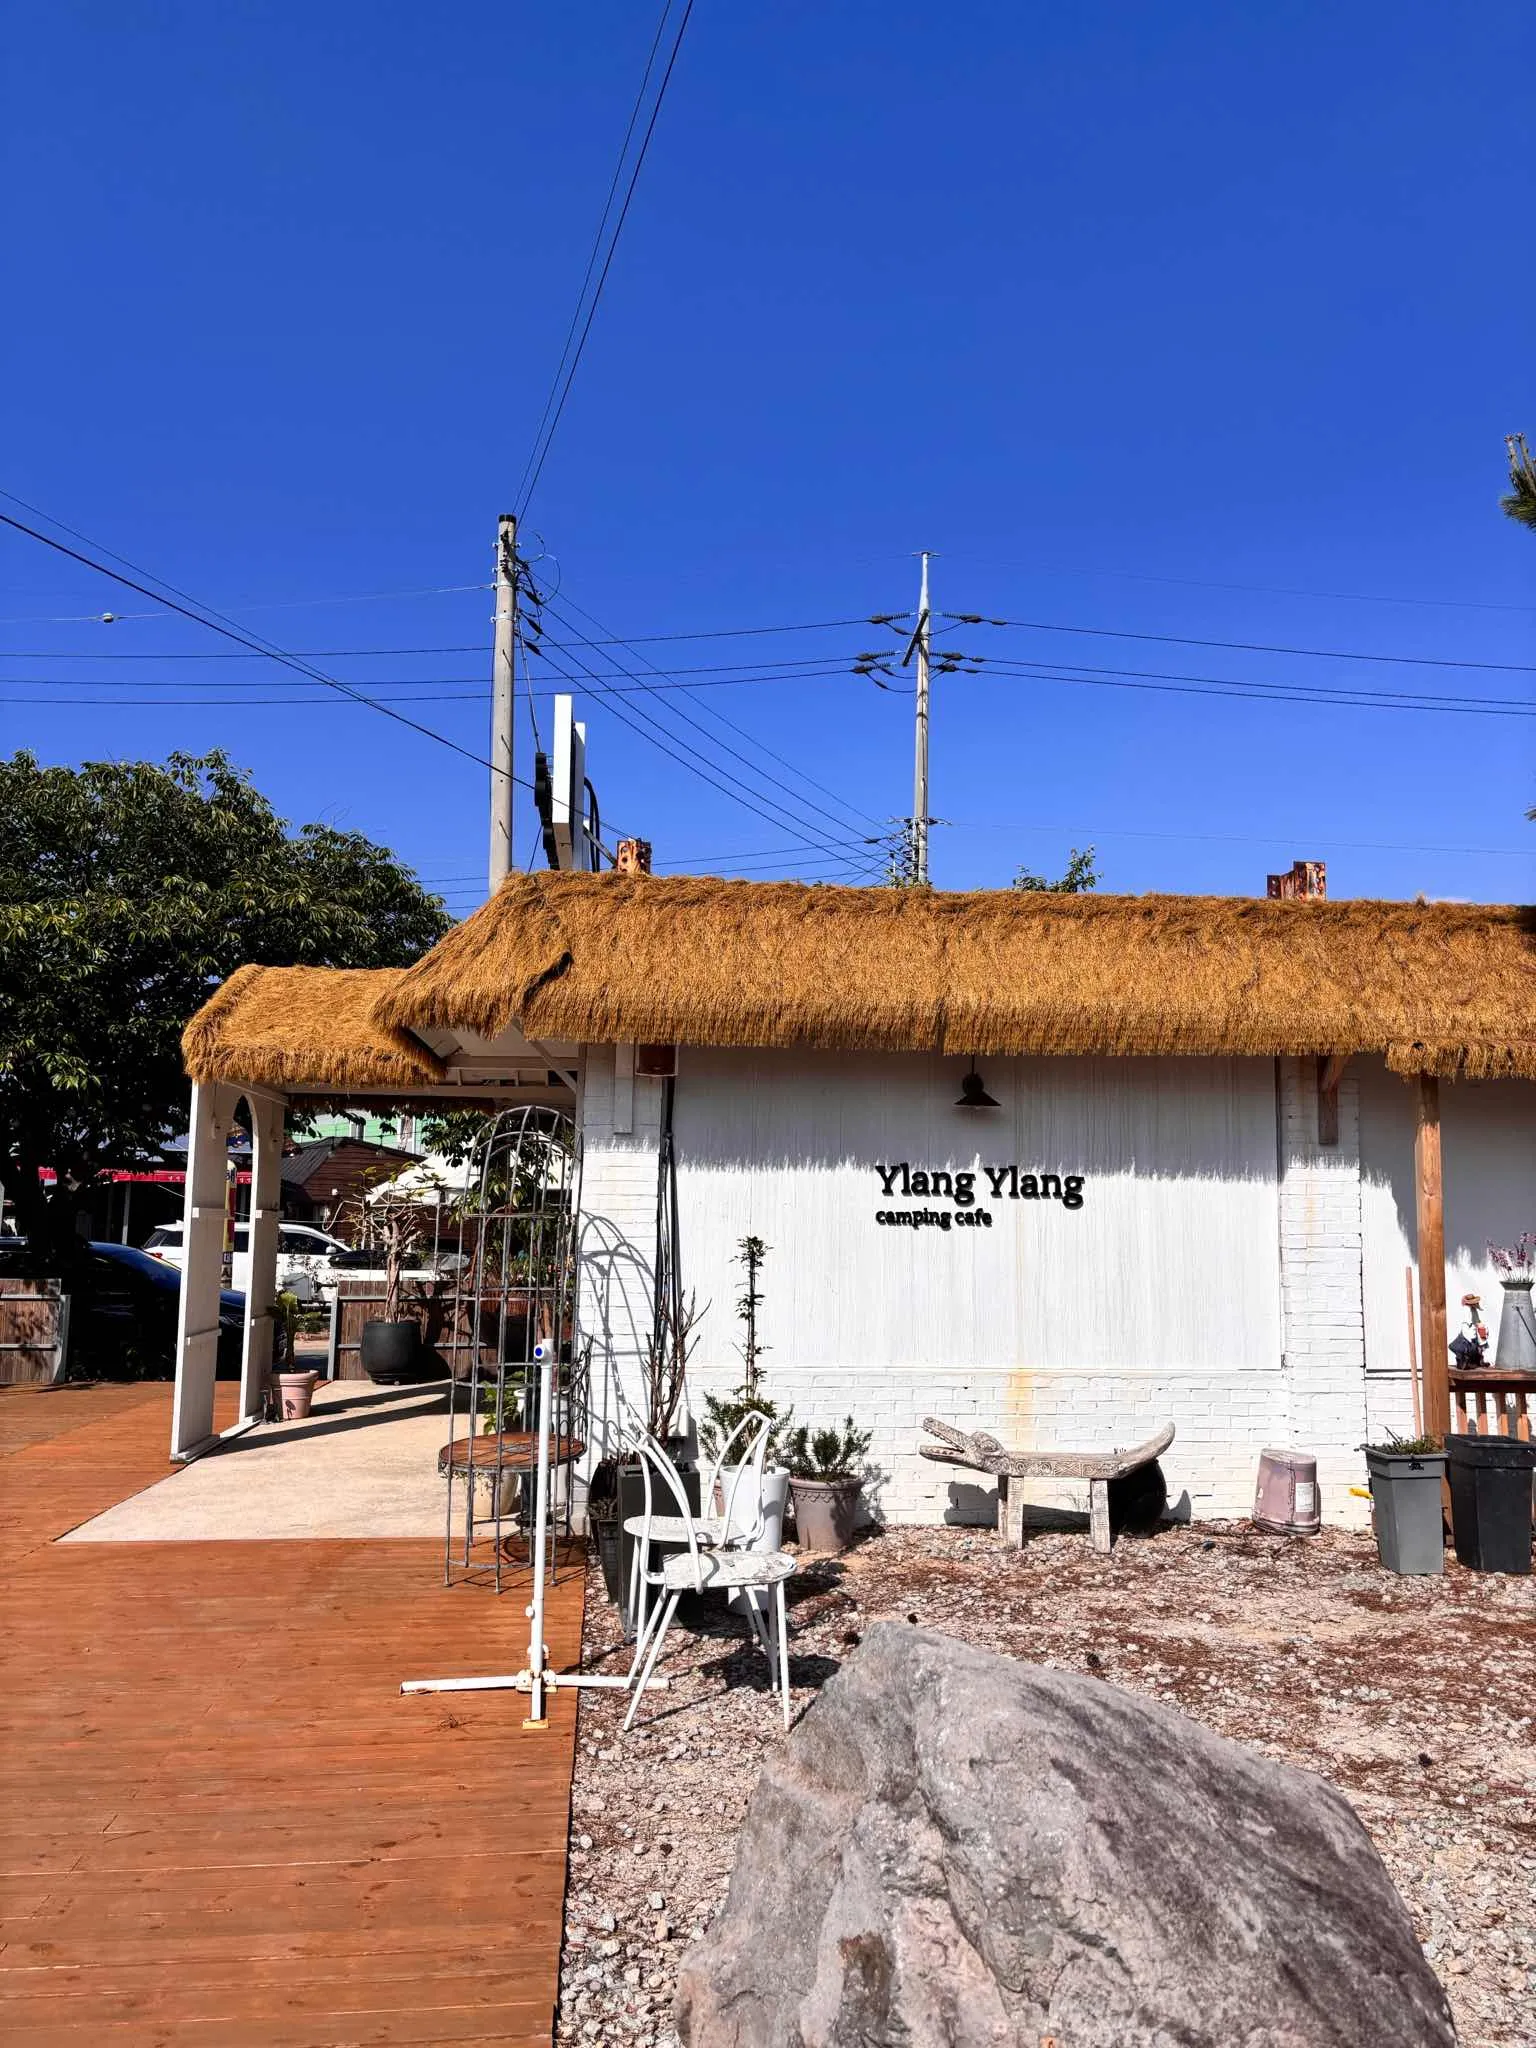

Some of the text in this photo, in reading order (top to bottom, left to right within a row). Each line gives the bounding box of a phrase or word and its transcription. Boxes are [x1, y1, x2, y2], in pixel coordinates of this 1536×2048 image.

[875, 1162, 1084, 1209] Ylang Ylang
[875, 1208, 993, 1230] camping cafe
